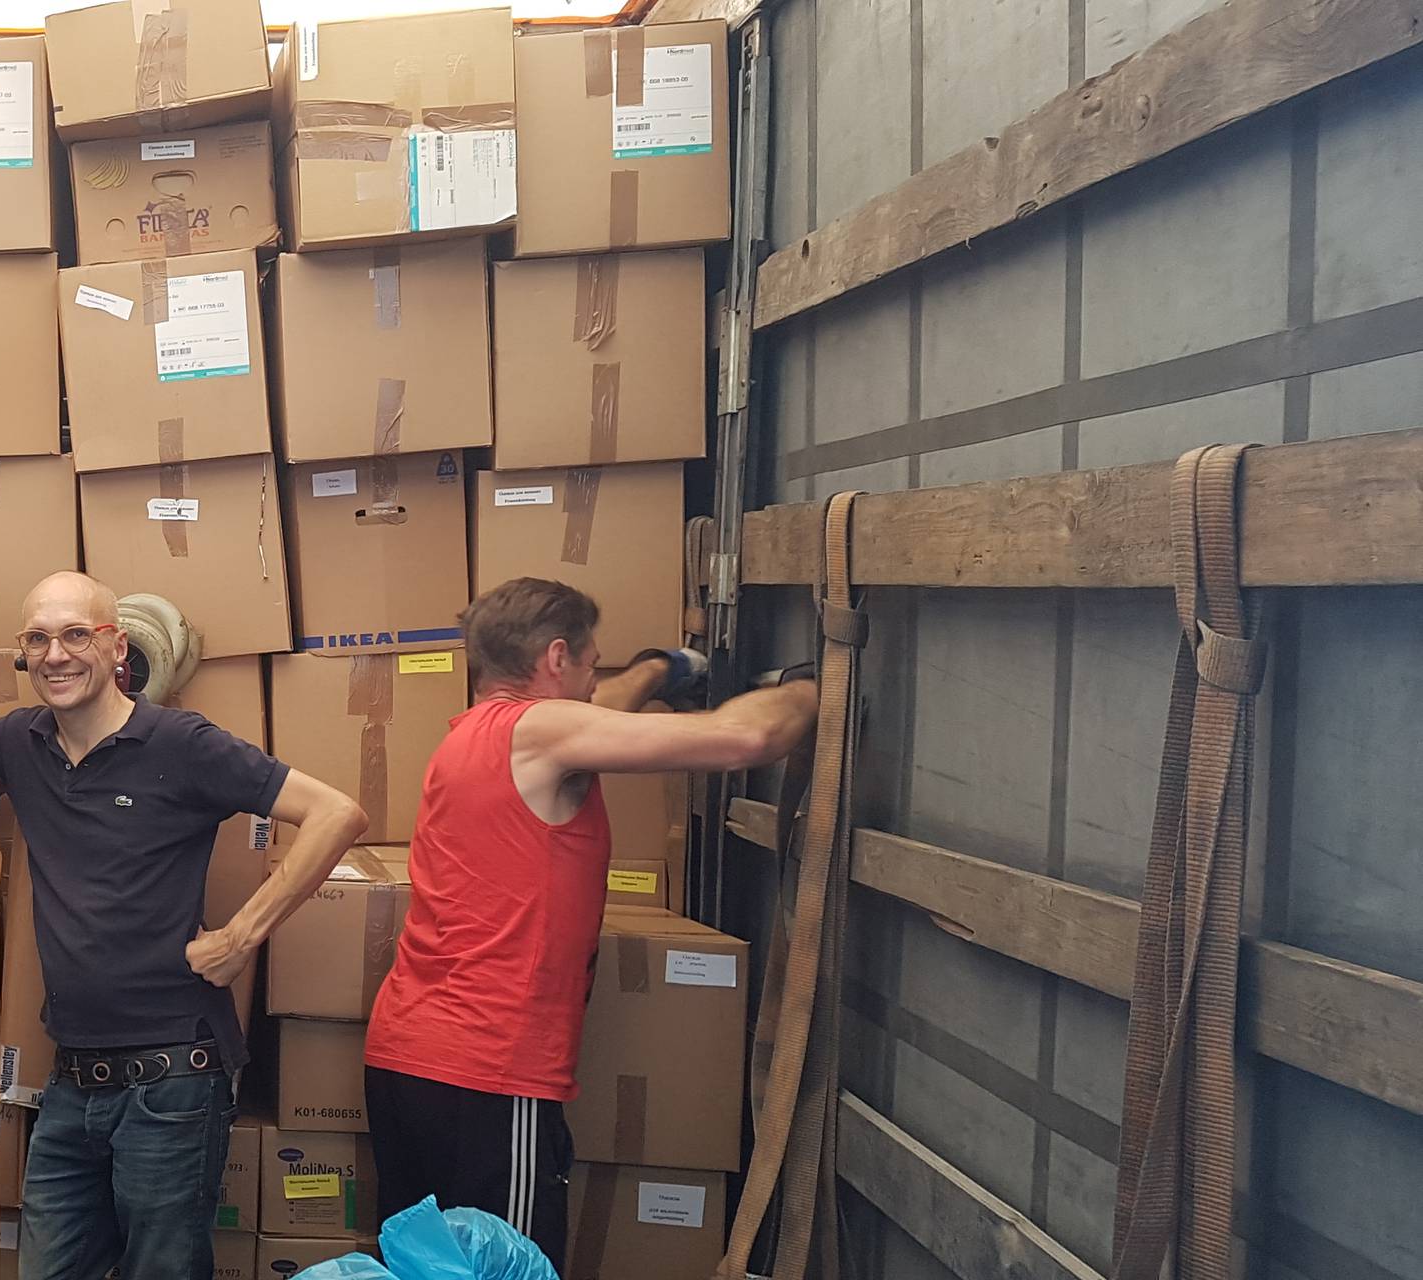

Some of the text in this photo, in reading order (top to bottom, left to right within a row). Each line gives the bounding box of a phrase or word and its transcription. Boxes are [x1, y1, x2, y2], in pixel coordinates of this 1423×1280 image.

[137, 207, 210, 235] FITA
[328, 632, 394, 648] IKEA
[294, 1106, 362, 1119] K01-680655
